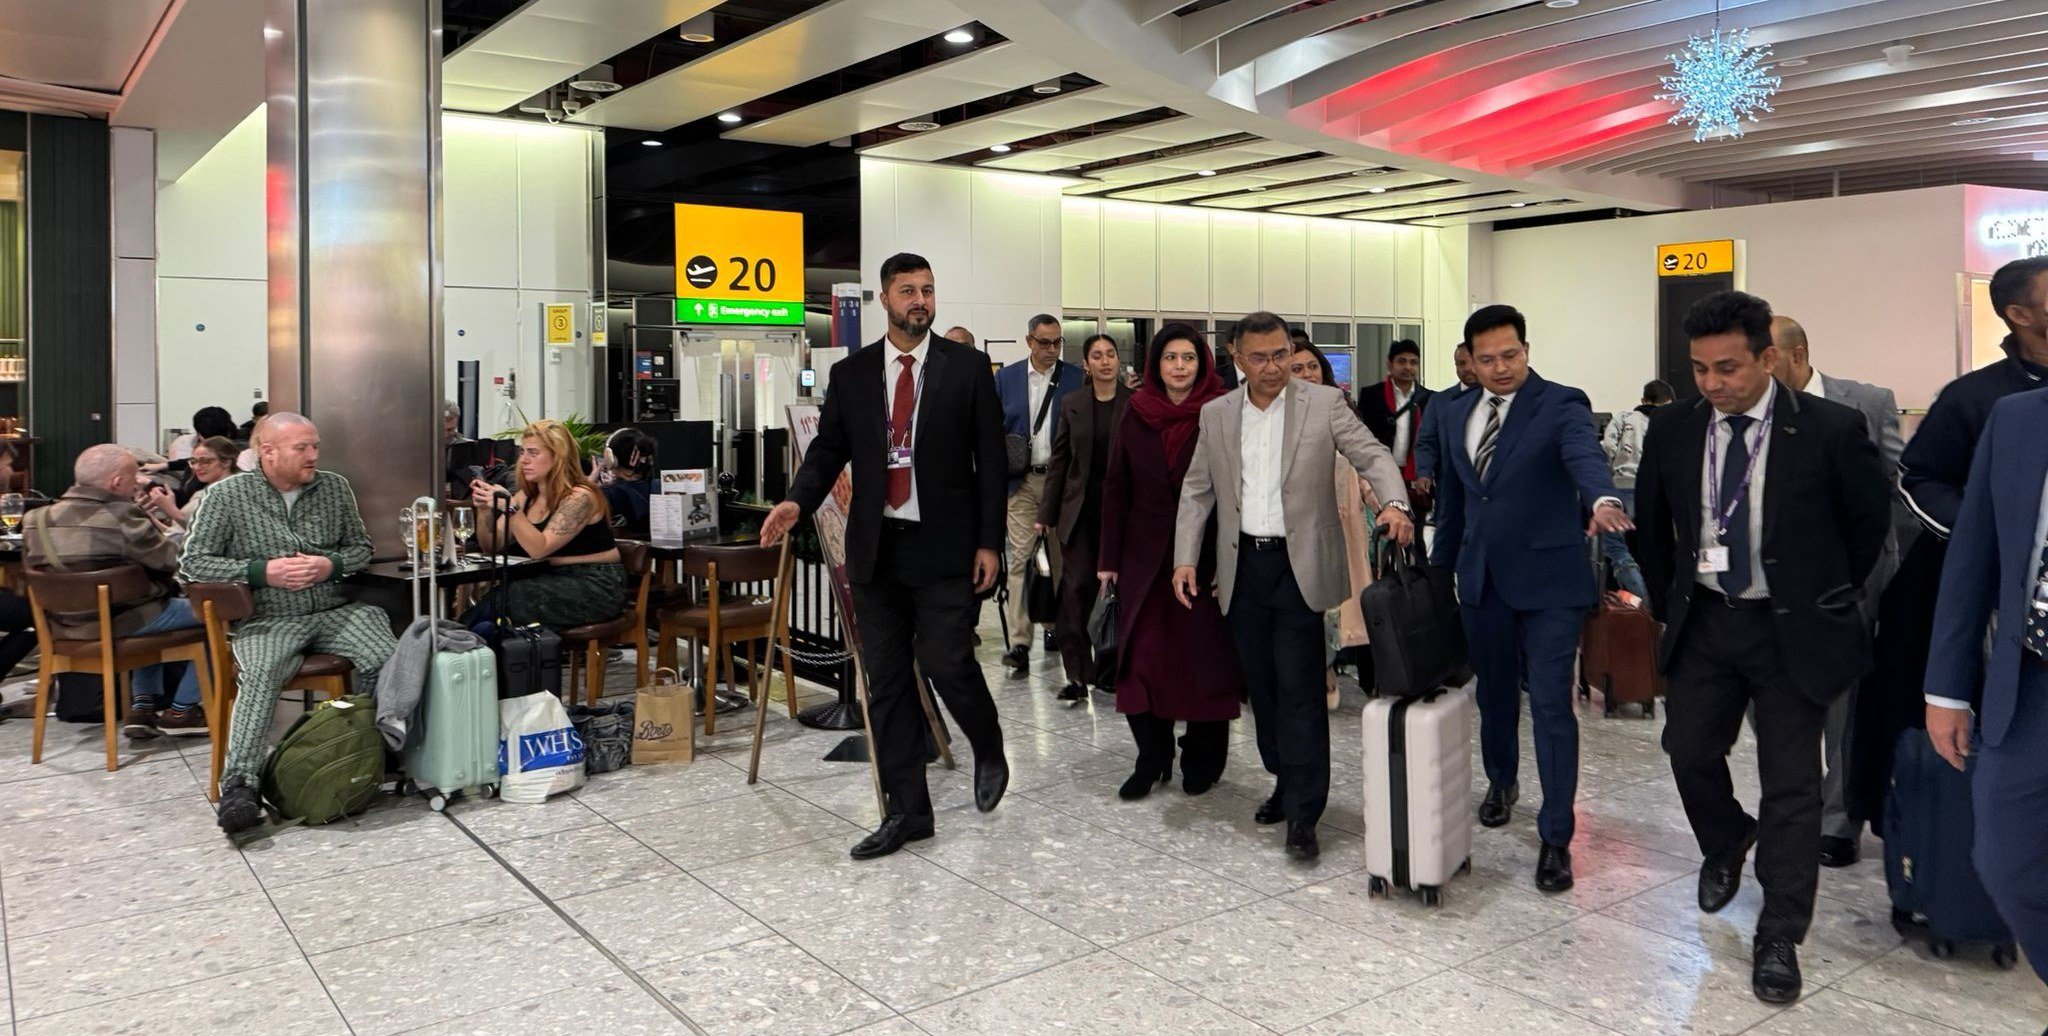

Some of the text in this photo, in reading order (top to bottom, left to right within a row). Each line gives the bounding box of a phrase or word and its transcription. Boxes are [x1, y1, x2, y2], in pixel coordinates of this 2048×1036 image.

[1683, 252, 1708, 270] 20
[729, 257, 776, 292] 20
[720, 305, 789, 318] Emergency exit
[524, 730, 586, 758] WHS
